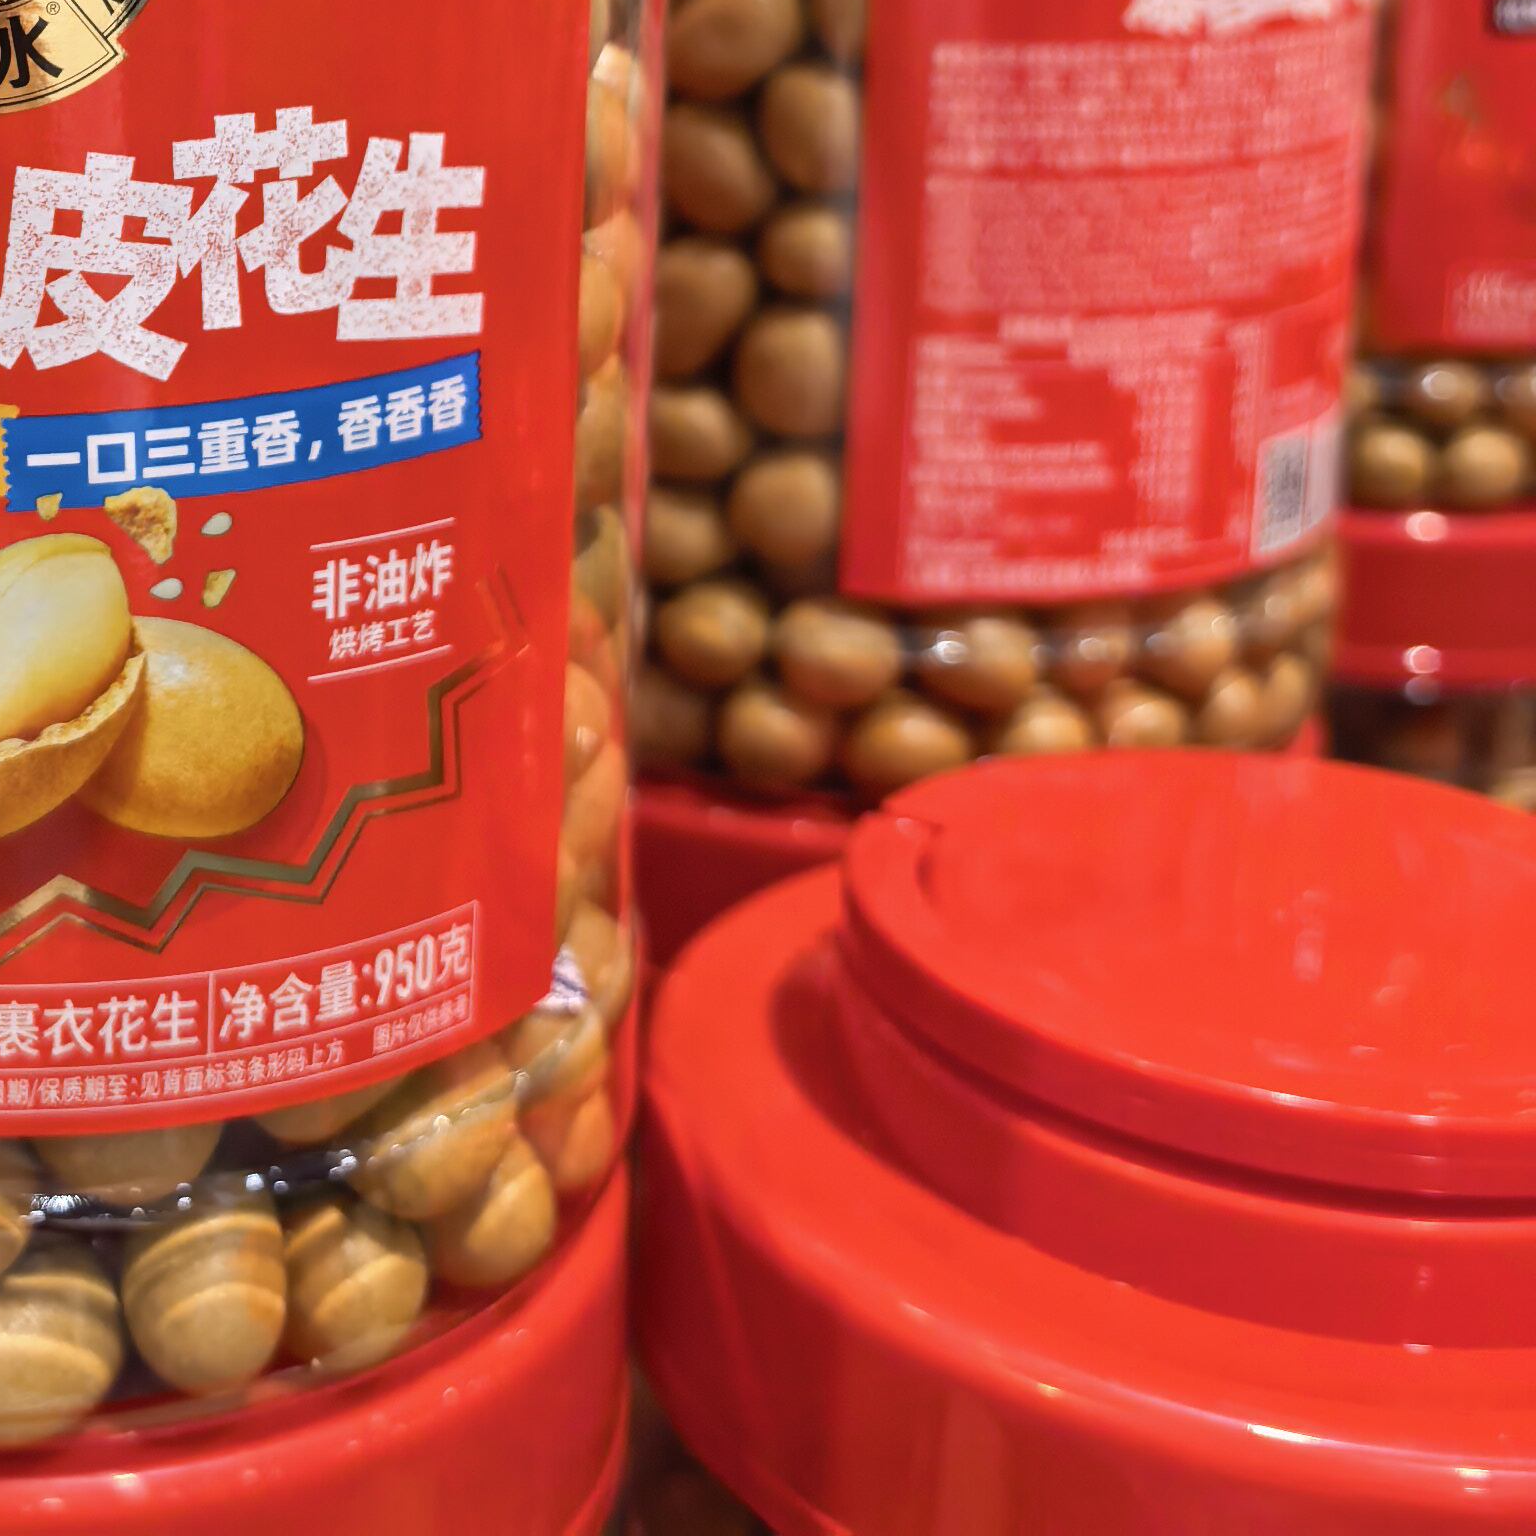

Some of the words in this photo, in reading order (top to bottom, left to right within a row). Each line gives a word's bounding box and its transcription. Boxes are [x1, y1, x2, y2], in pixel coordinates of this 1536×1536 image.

[311, 539, 454, 621] 非油炸
[328, 608, 436, 661] 烘烤工艺
